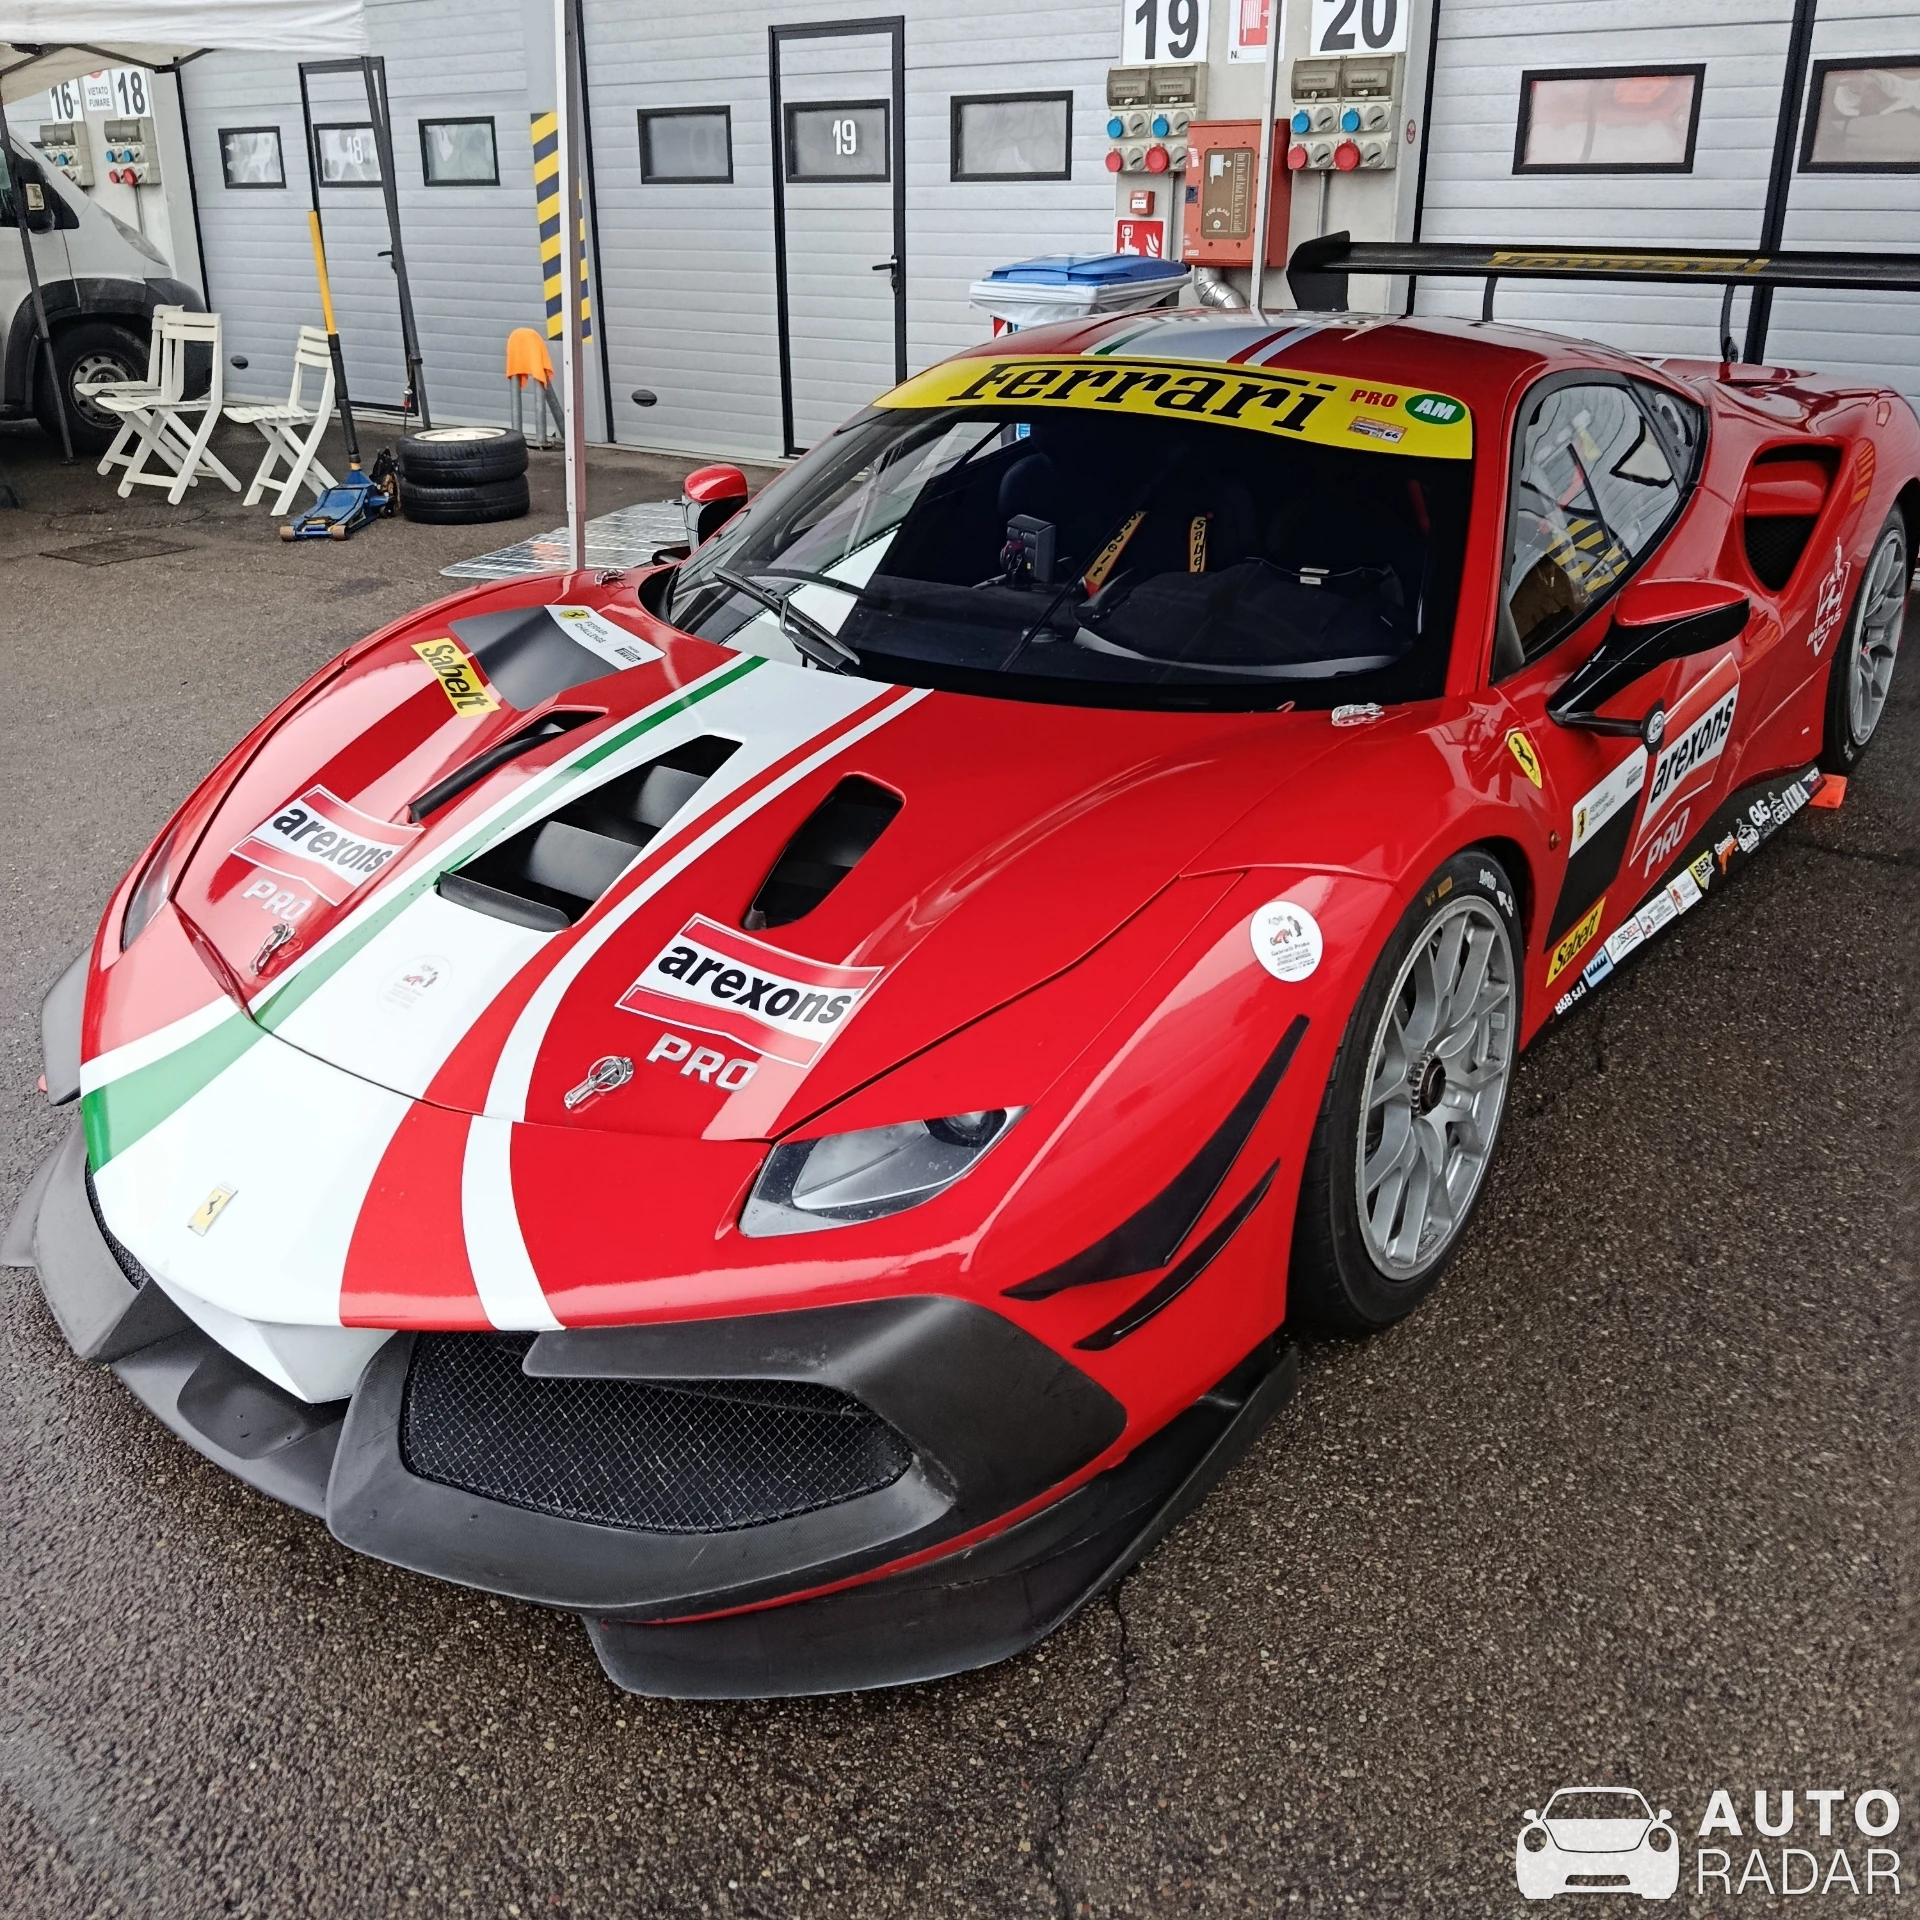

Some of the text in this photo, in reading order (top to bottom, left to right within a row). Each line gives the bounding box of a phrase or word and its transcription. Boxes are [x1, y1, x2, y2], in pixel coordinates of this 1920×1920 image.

[1135, 0, 1199, 60] 19
[1320, 0, 1397, 51] 20
[51, 82, 74, 119] 16
[87, 86, 108, 95] VIETATO
[89, 98, 110, 107] FUMARE
[118, 71, 145, 115] 18
[346, 136, 364, 164] 18
[832, 119, 857, 155] 19
[946, 360, 1338, 432] Ferrari
[1350, 389, 1457, 420] PRO AM
[1384, 430, 1399, 439] 66
[422, 644, 489, 710] Sabelt
[1650, 697, 1735, 804] arexons
[272, 808, 393, 873] arexons
[1643, 807, 1691, 879] PRO
[241, 878, 312, 922] PRO
[658, 945, 852, 1024] arexons
[646, 1033, 759, 1091] PRO
